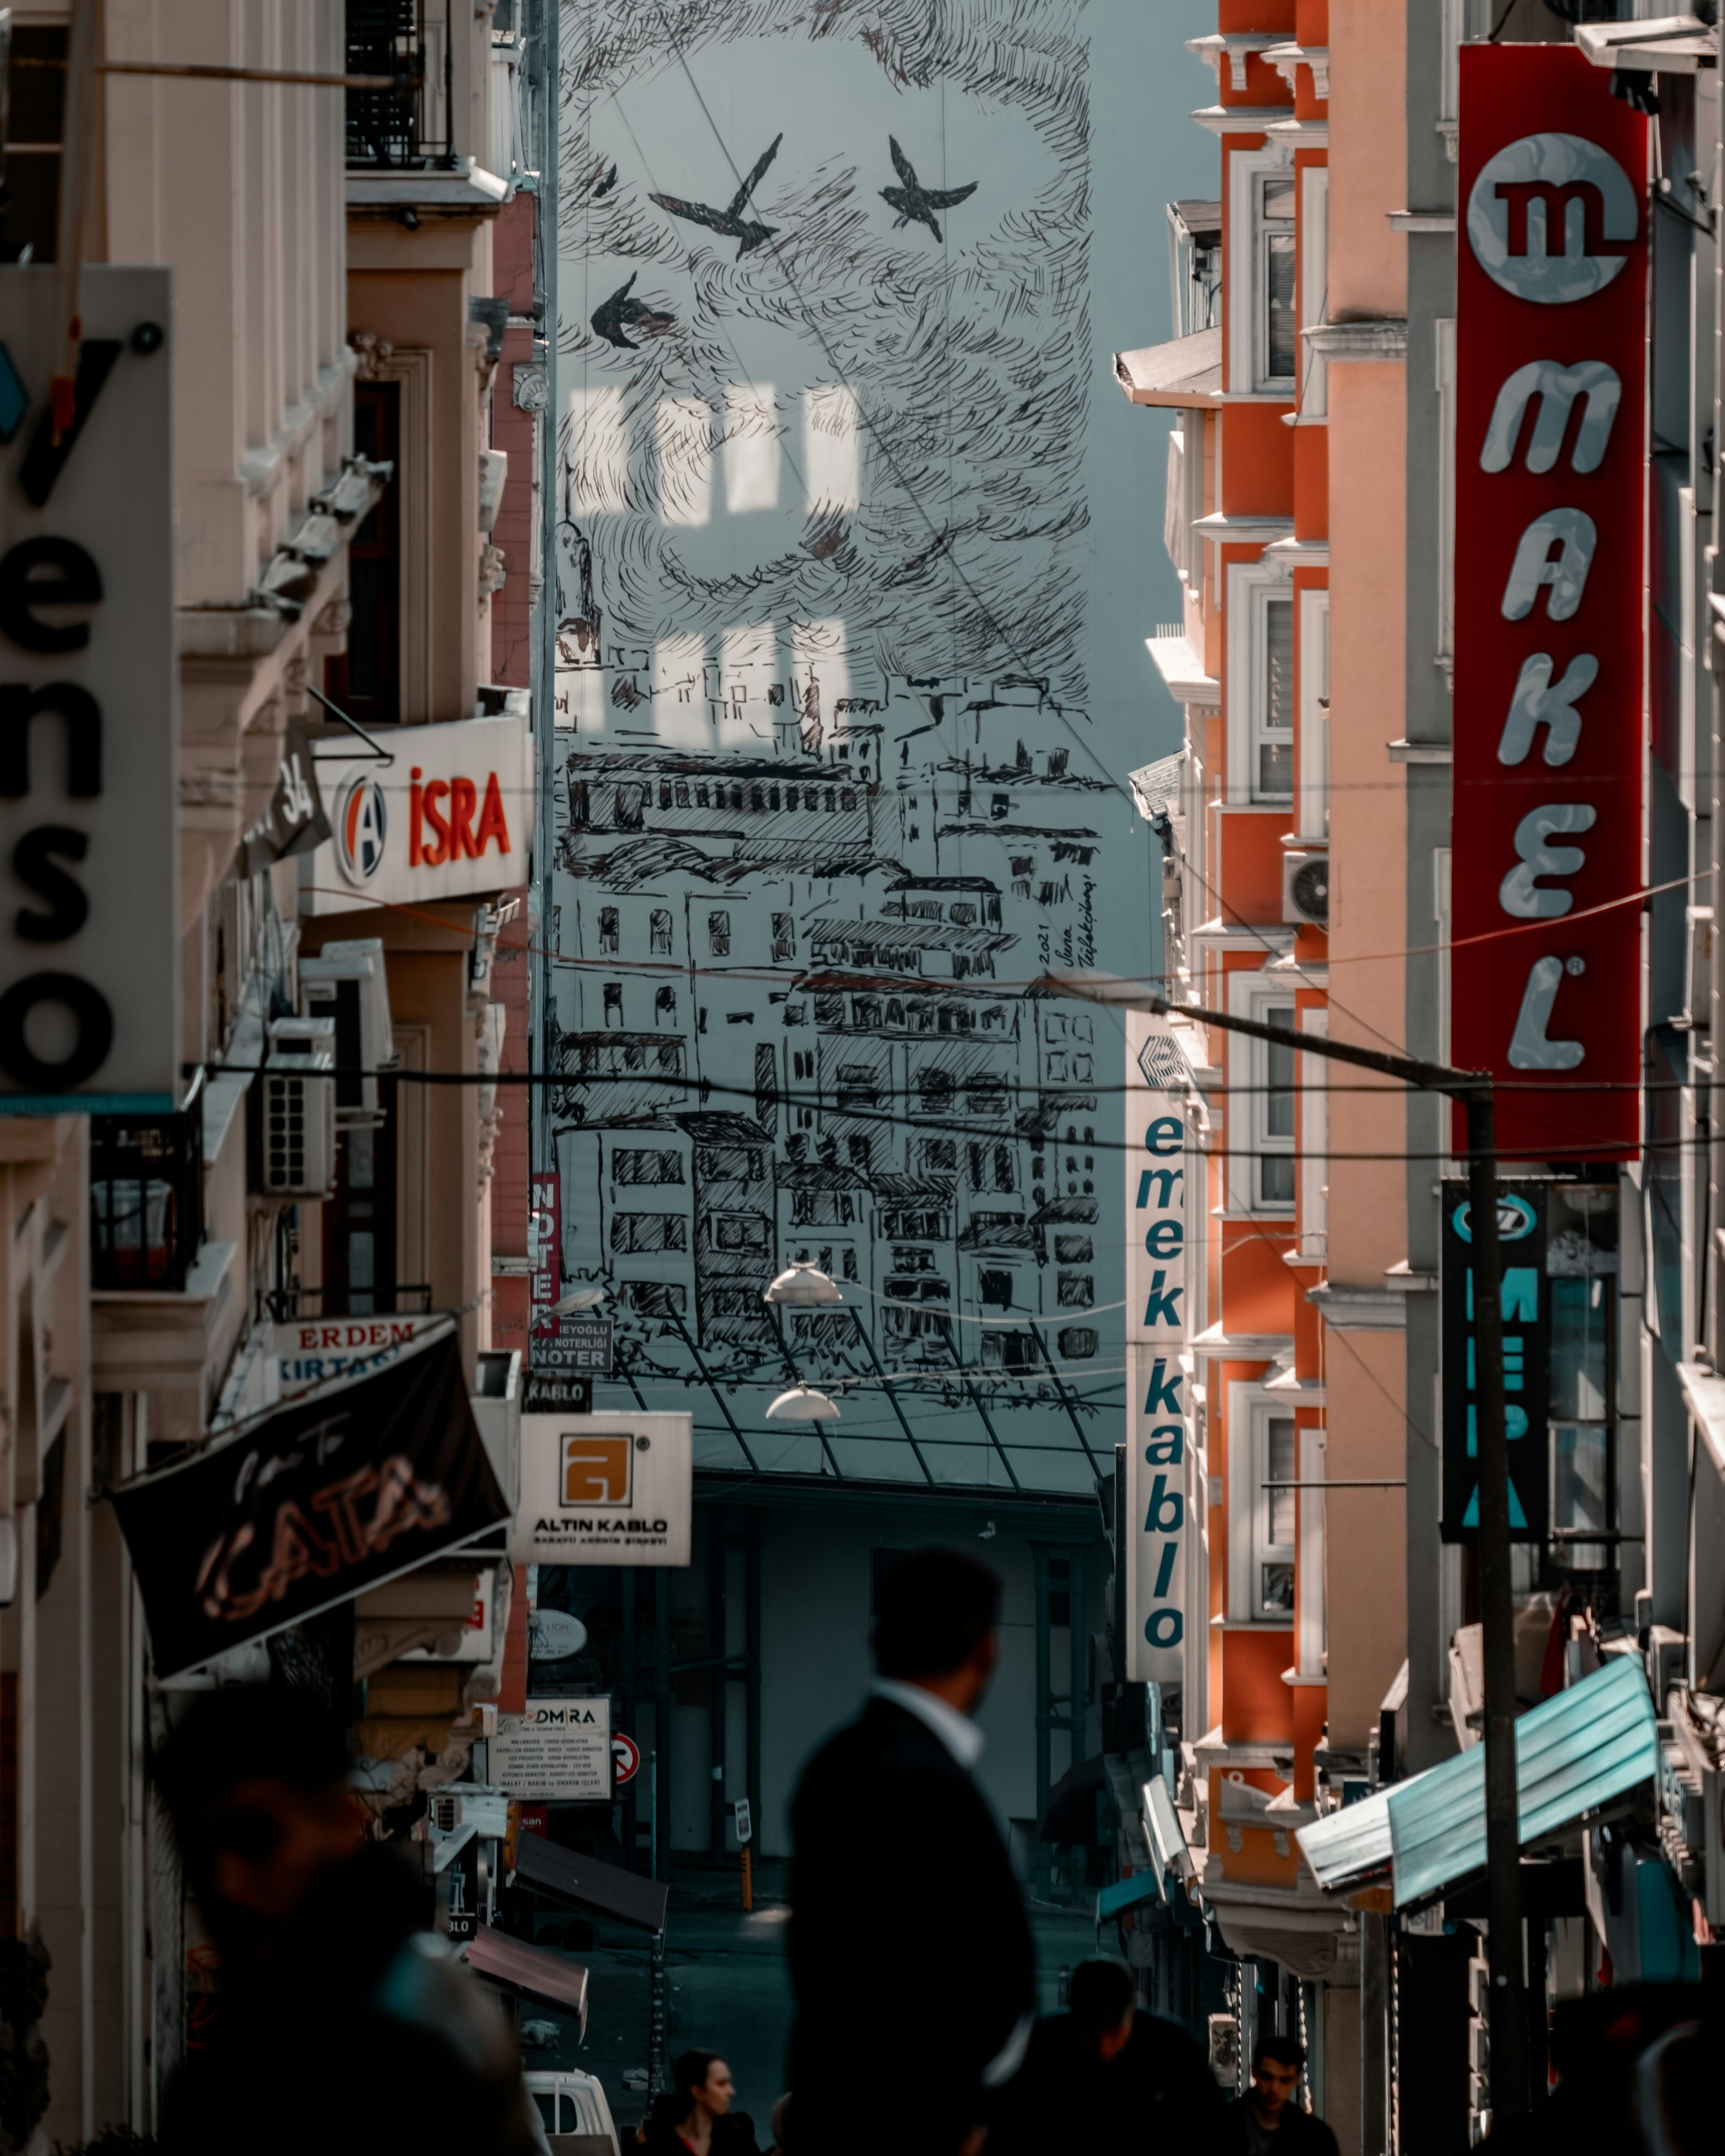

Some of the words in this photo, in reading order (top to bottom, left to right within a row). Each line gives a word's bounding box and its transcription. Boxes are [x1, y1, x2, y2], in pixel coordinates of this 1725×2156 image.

[1037, 924, 1050, 965] 2021
[1136, 1116, 1184, 1326] emek
[532, 1183, 554, 1329] NOTER
[300, 1323, 414, 1350] ERDEM
[533, 1350, 604, 1366] NOTER
[528, 1382, 584, 1401] KABLO
[1144, 1358, 1183, 1648] kablo
[535, 1518, 593, 1533] ALTIN
[598, 1518, 668, 1533] KABLO
[547, 1624, 569, 1632] LION
